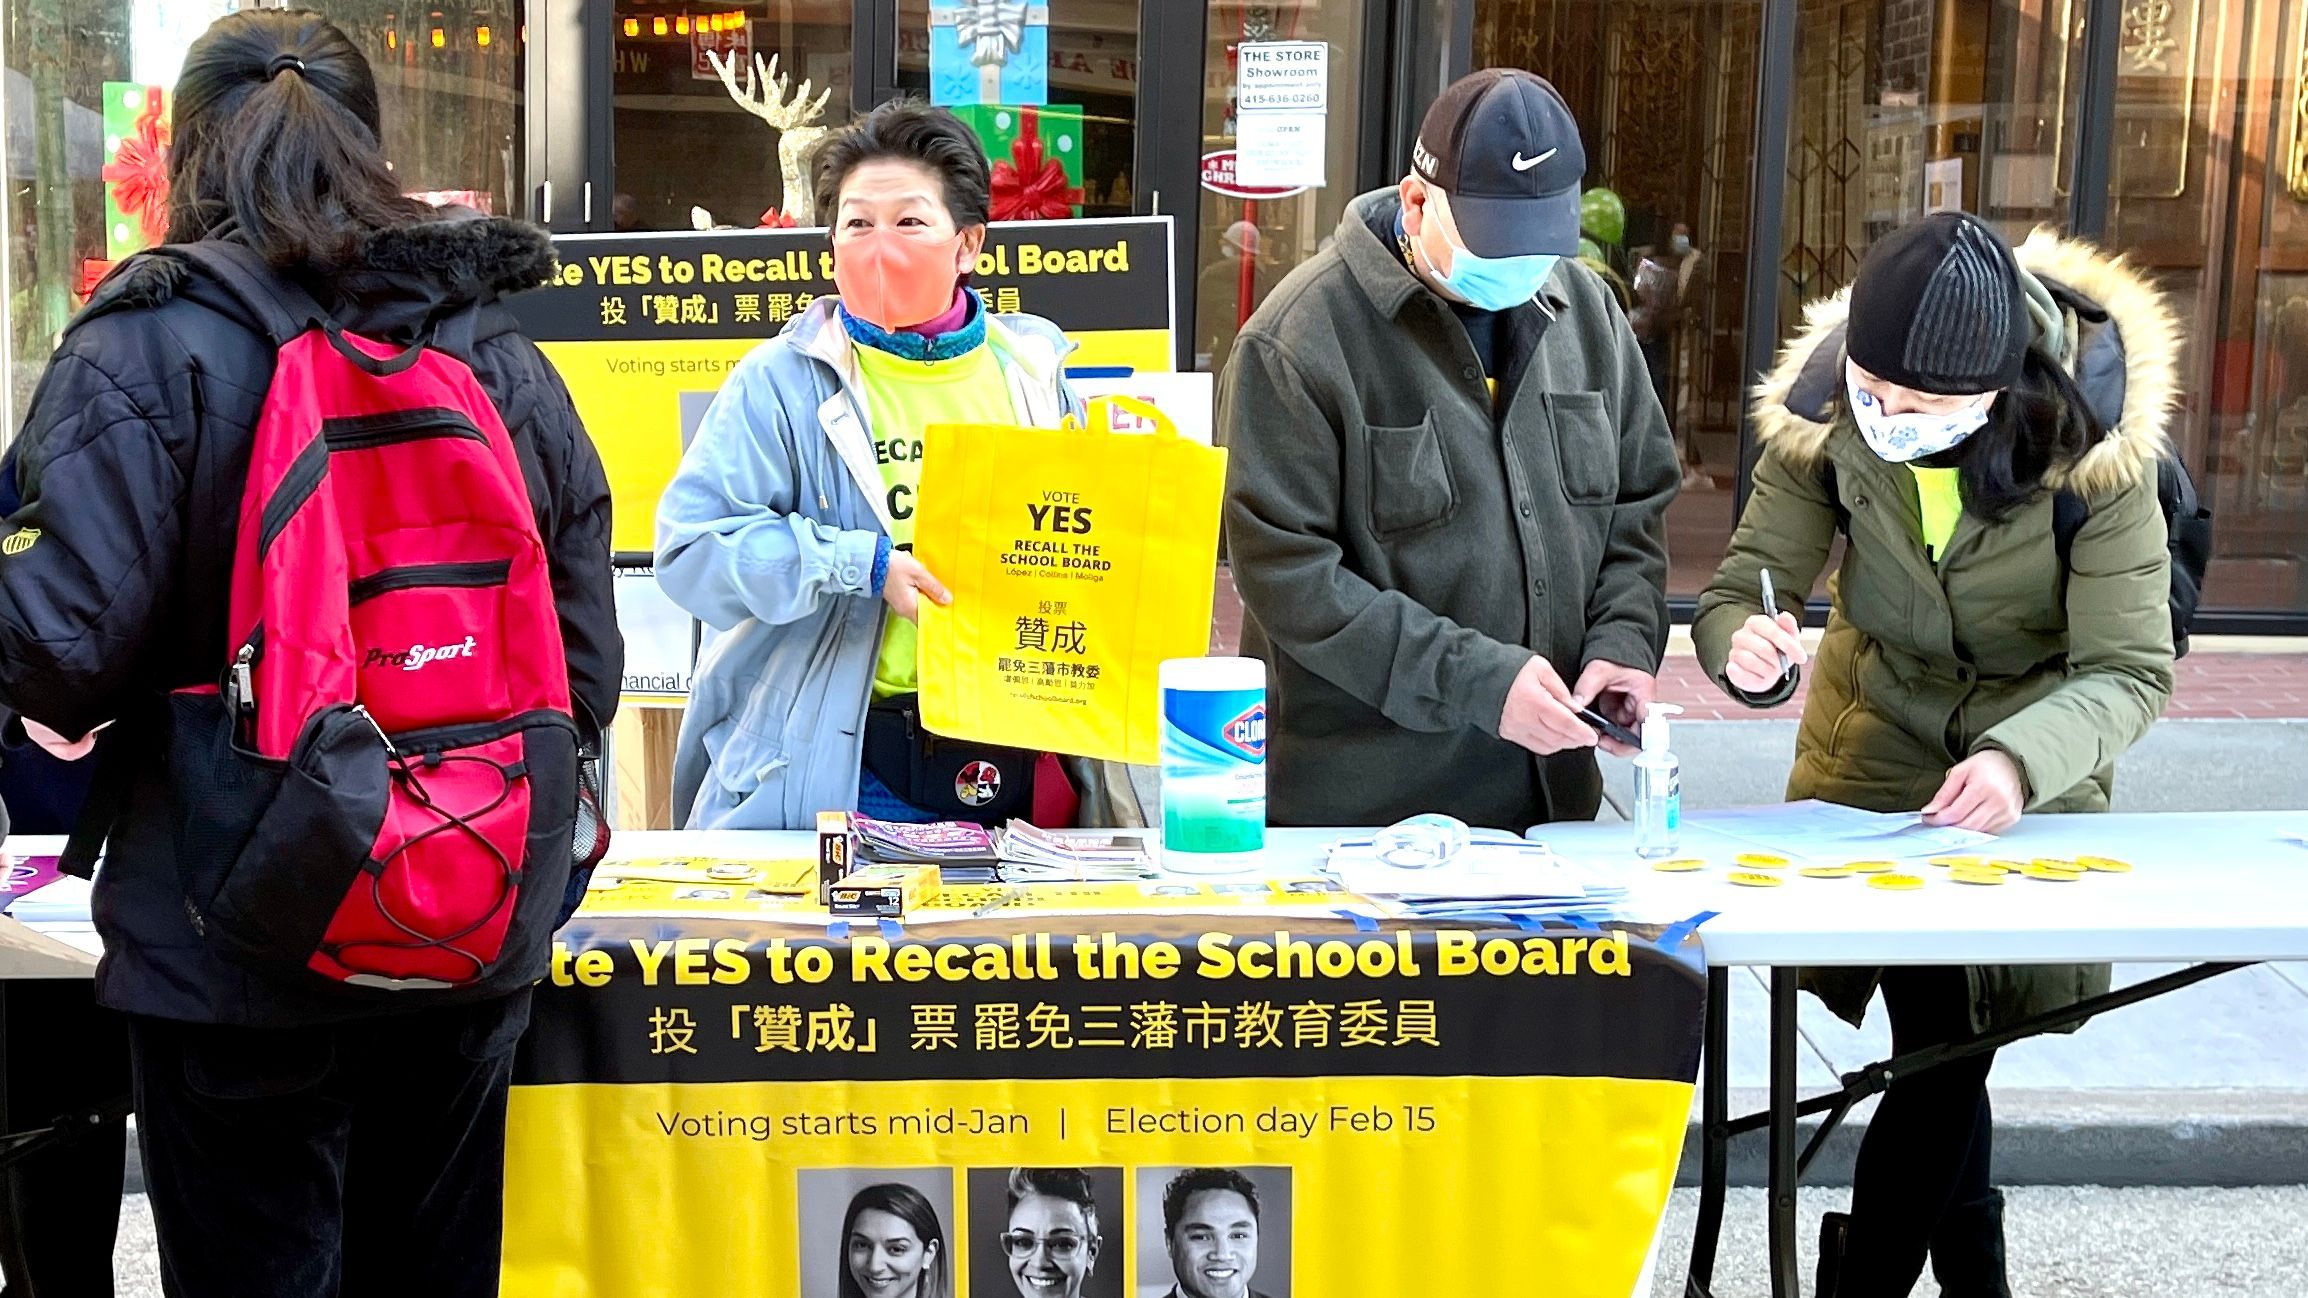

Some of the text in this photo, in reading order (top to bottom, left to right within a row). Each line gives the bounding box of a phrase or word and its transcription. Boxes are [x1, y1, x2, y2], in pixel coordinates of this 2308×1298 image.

[1244, 50, 1321, 62] THE STORE
[1247, 67, 1318, 78] Showroom
[589, 256, 652, 285] YES
[659, 256, 695, 283] to
[702, 251, 813, 283] Recall
[1018, 241, 1129, 275] Board
[607, 358, 665, 376] Voting
[671, 358, 720, 372] starts
[875, 438, 923, 464] ECA
[1043, 491, 1080, 504] VOTE
[1027, 504, 1093, 534] YES
[1015, 540, 1100, 556] RECALL THE
[1000, 553, 1111, 571] SCHOOL BOARD
[1038, 600, 1067, 615] 投票
[1015, 616, 1087, 655] 贊成
[364, 635, 477, 671] ProSport
[1234, 718, 1267, 743] CLOR
[628, 938, 752, 986] YES
[766, 937, 833, 984] to
[850, 932, 1061, 982] Recall
[1072, 930, 1182, 980] the
[1196, 930, 1421, 979] School
[1436, 929, 1632, 977] Board
[656, 1105, 1436, 1142] Voting starts mid-Jan Election day Feb 15
